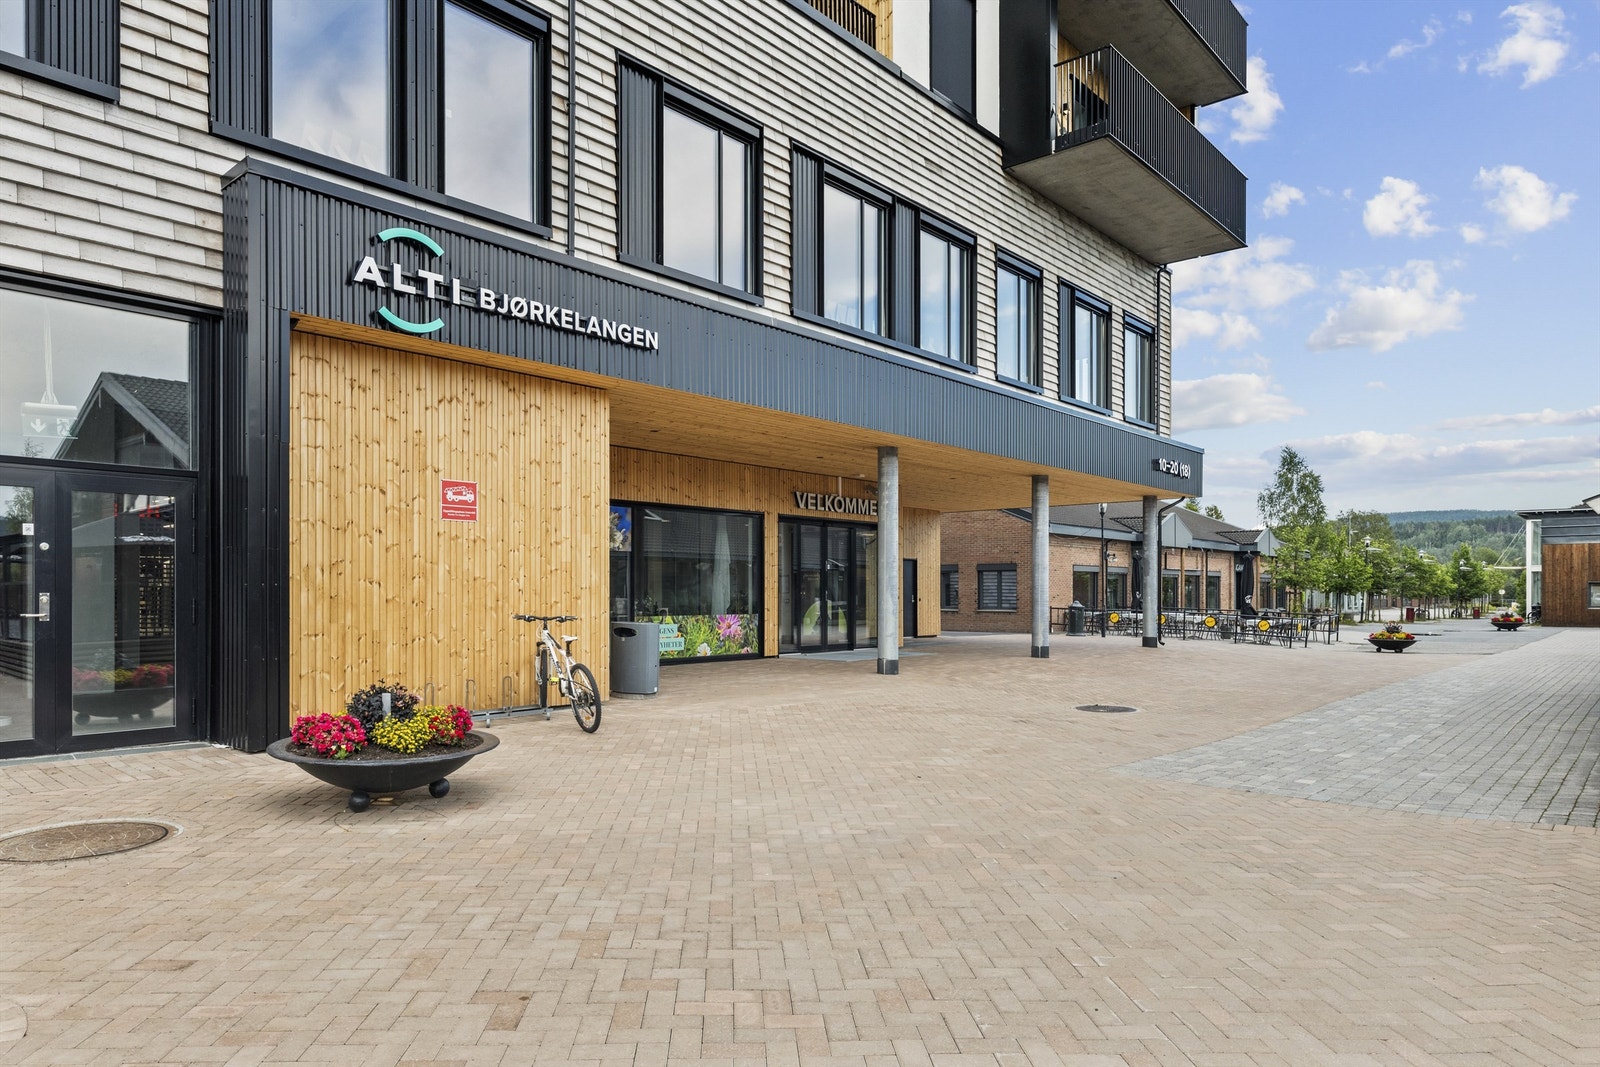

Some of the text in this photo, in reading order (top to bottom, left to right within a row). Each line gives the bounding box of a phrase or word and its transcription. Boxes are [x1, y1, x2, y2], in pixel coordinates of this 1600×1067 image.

[353, 256, 659, 350] ALTI BJØRKELANGEN
[1180, 463, 1190, 479] (18)
[796, 491, 877, 515] VELKOMME
